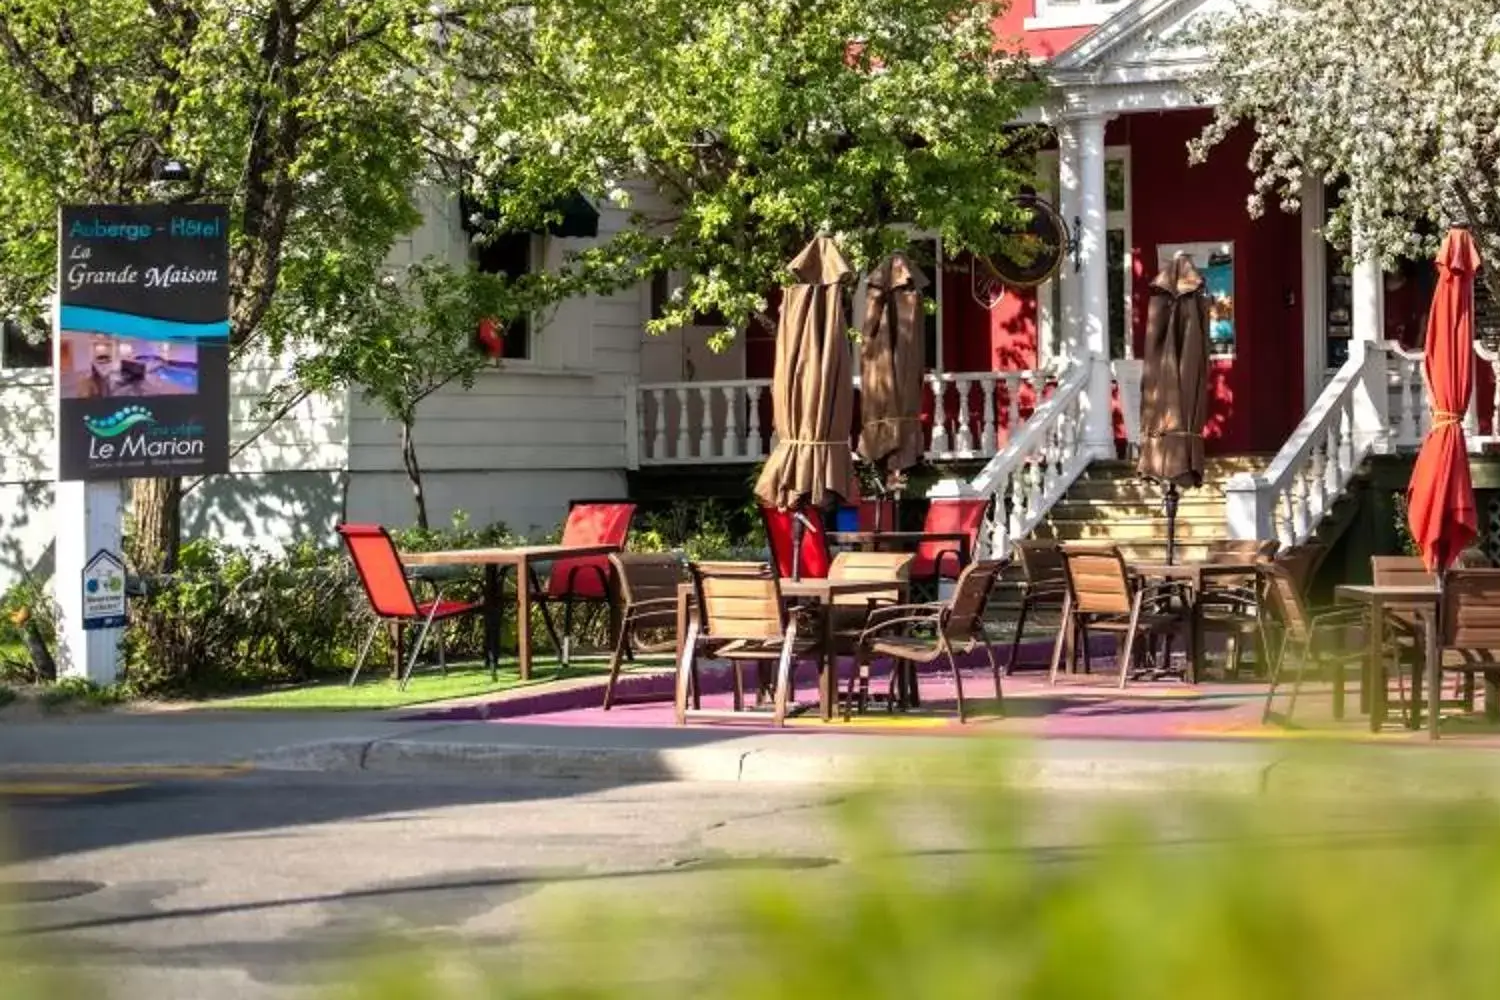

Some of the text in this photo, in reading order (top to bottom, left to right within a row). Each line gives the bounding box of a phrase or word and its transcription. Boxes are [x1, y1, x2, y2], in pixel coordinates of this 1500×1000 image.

[69, 218, 152, 241] Auberge
[171, 216, 220, 238] Hôtel
[69, 245, 92, 260] La
[68, 263, 219, 291] Grande Maison
[89, 433, 204, 460] Le Marion
